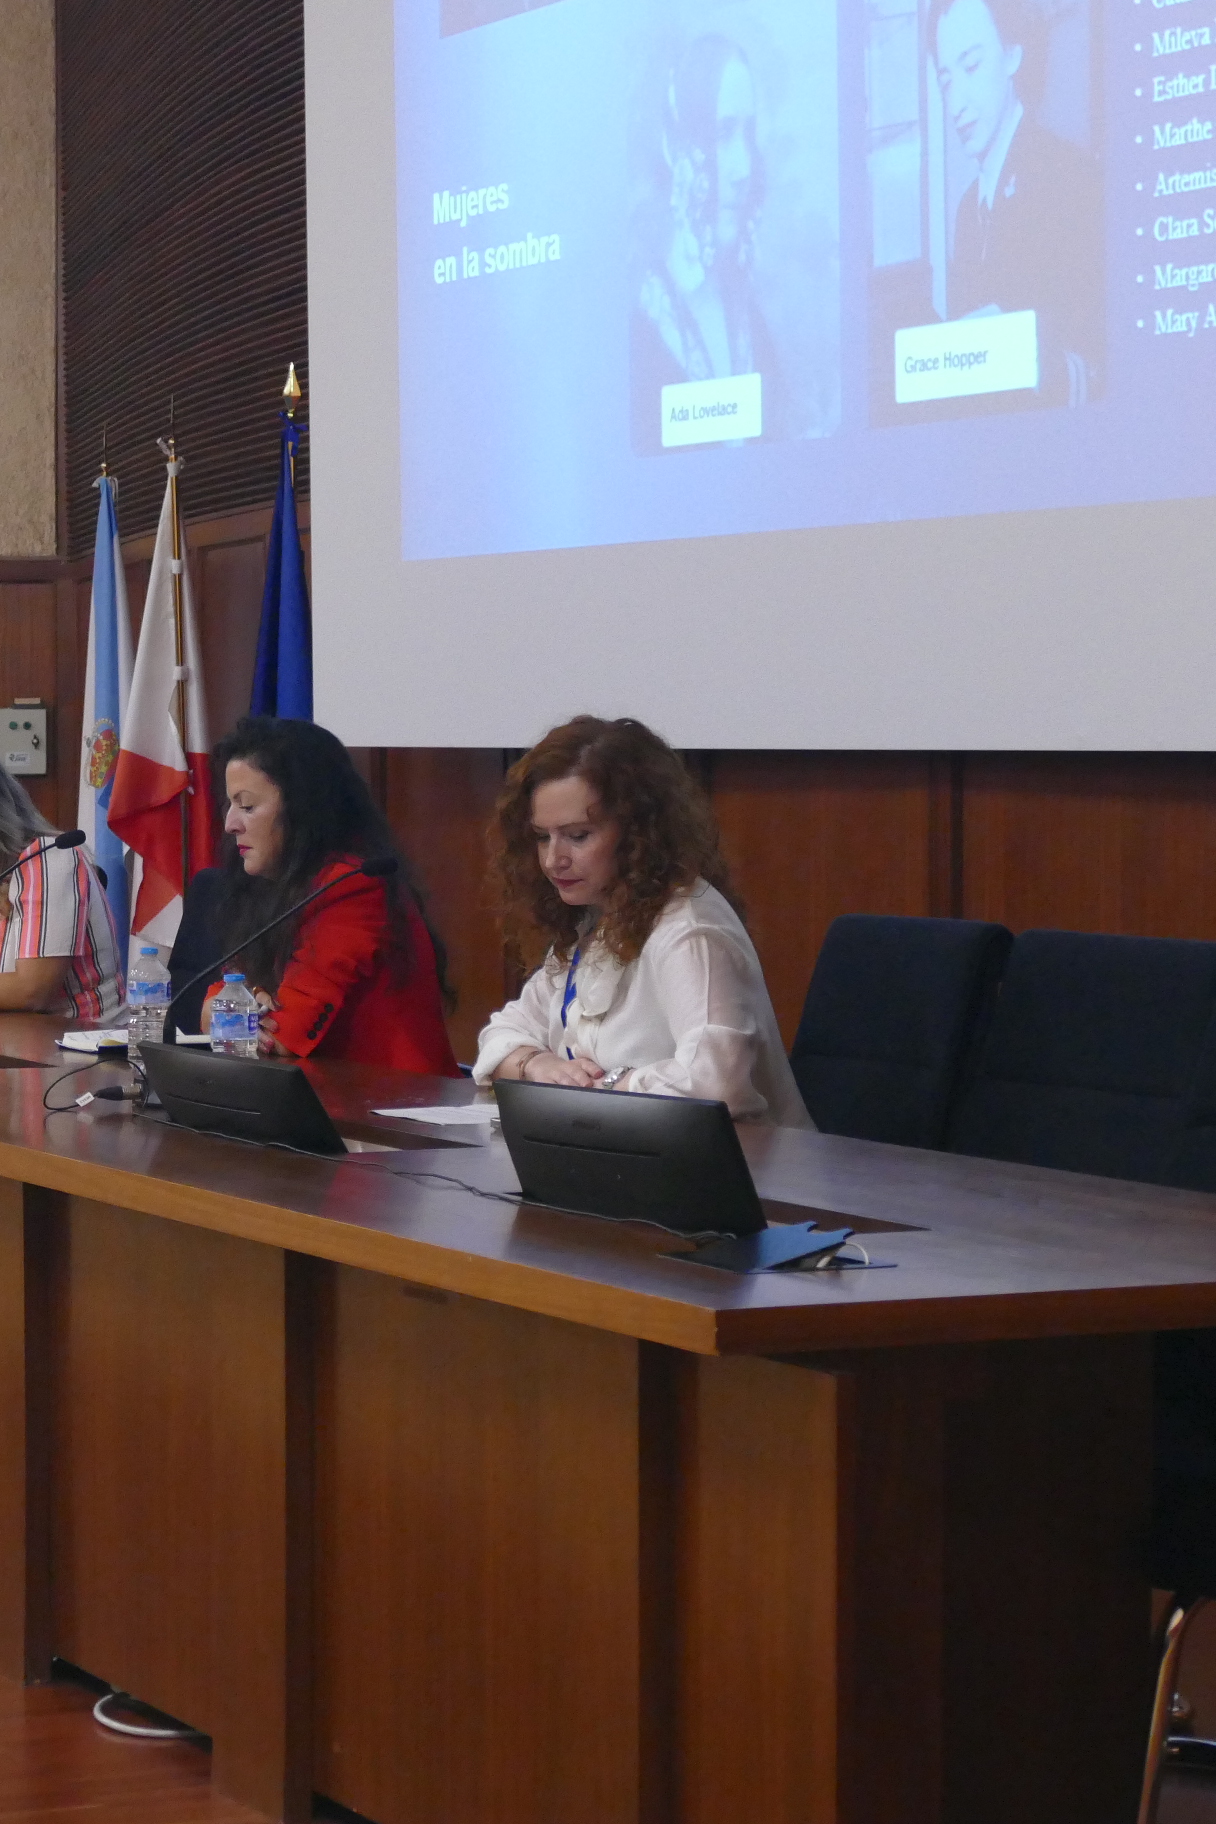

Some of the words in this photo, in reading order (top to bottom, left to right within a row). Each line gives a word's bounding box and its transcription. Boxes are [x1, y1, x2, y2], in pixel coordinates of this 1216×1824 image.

[1152, 26, 1211, 57] Mileva
[1152, 72, 1205, 102] Esther
[1152, 117, 1213, 150] Marthe
[433, 183, 509, 227] Mujeres
[1153, 215, 1200, 241] Clara
[434, 255, 457, 284] en
[462, 246, 480, 279] la
[484, 232, 561, 274] sombra
[1153, 263, 1216, 291] Margar
[1154, 308, 1199, 337] Mary
[904, 356, 940, 374] Grace
[943, 350, 989, 371] Hopper
[669, 406, 689, 423] Ada
[692, 402, 738, 420] Lovelace
